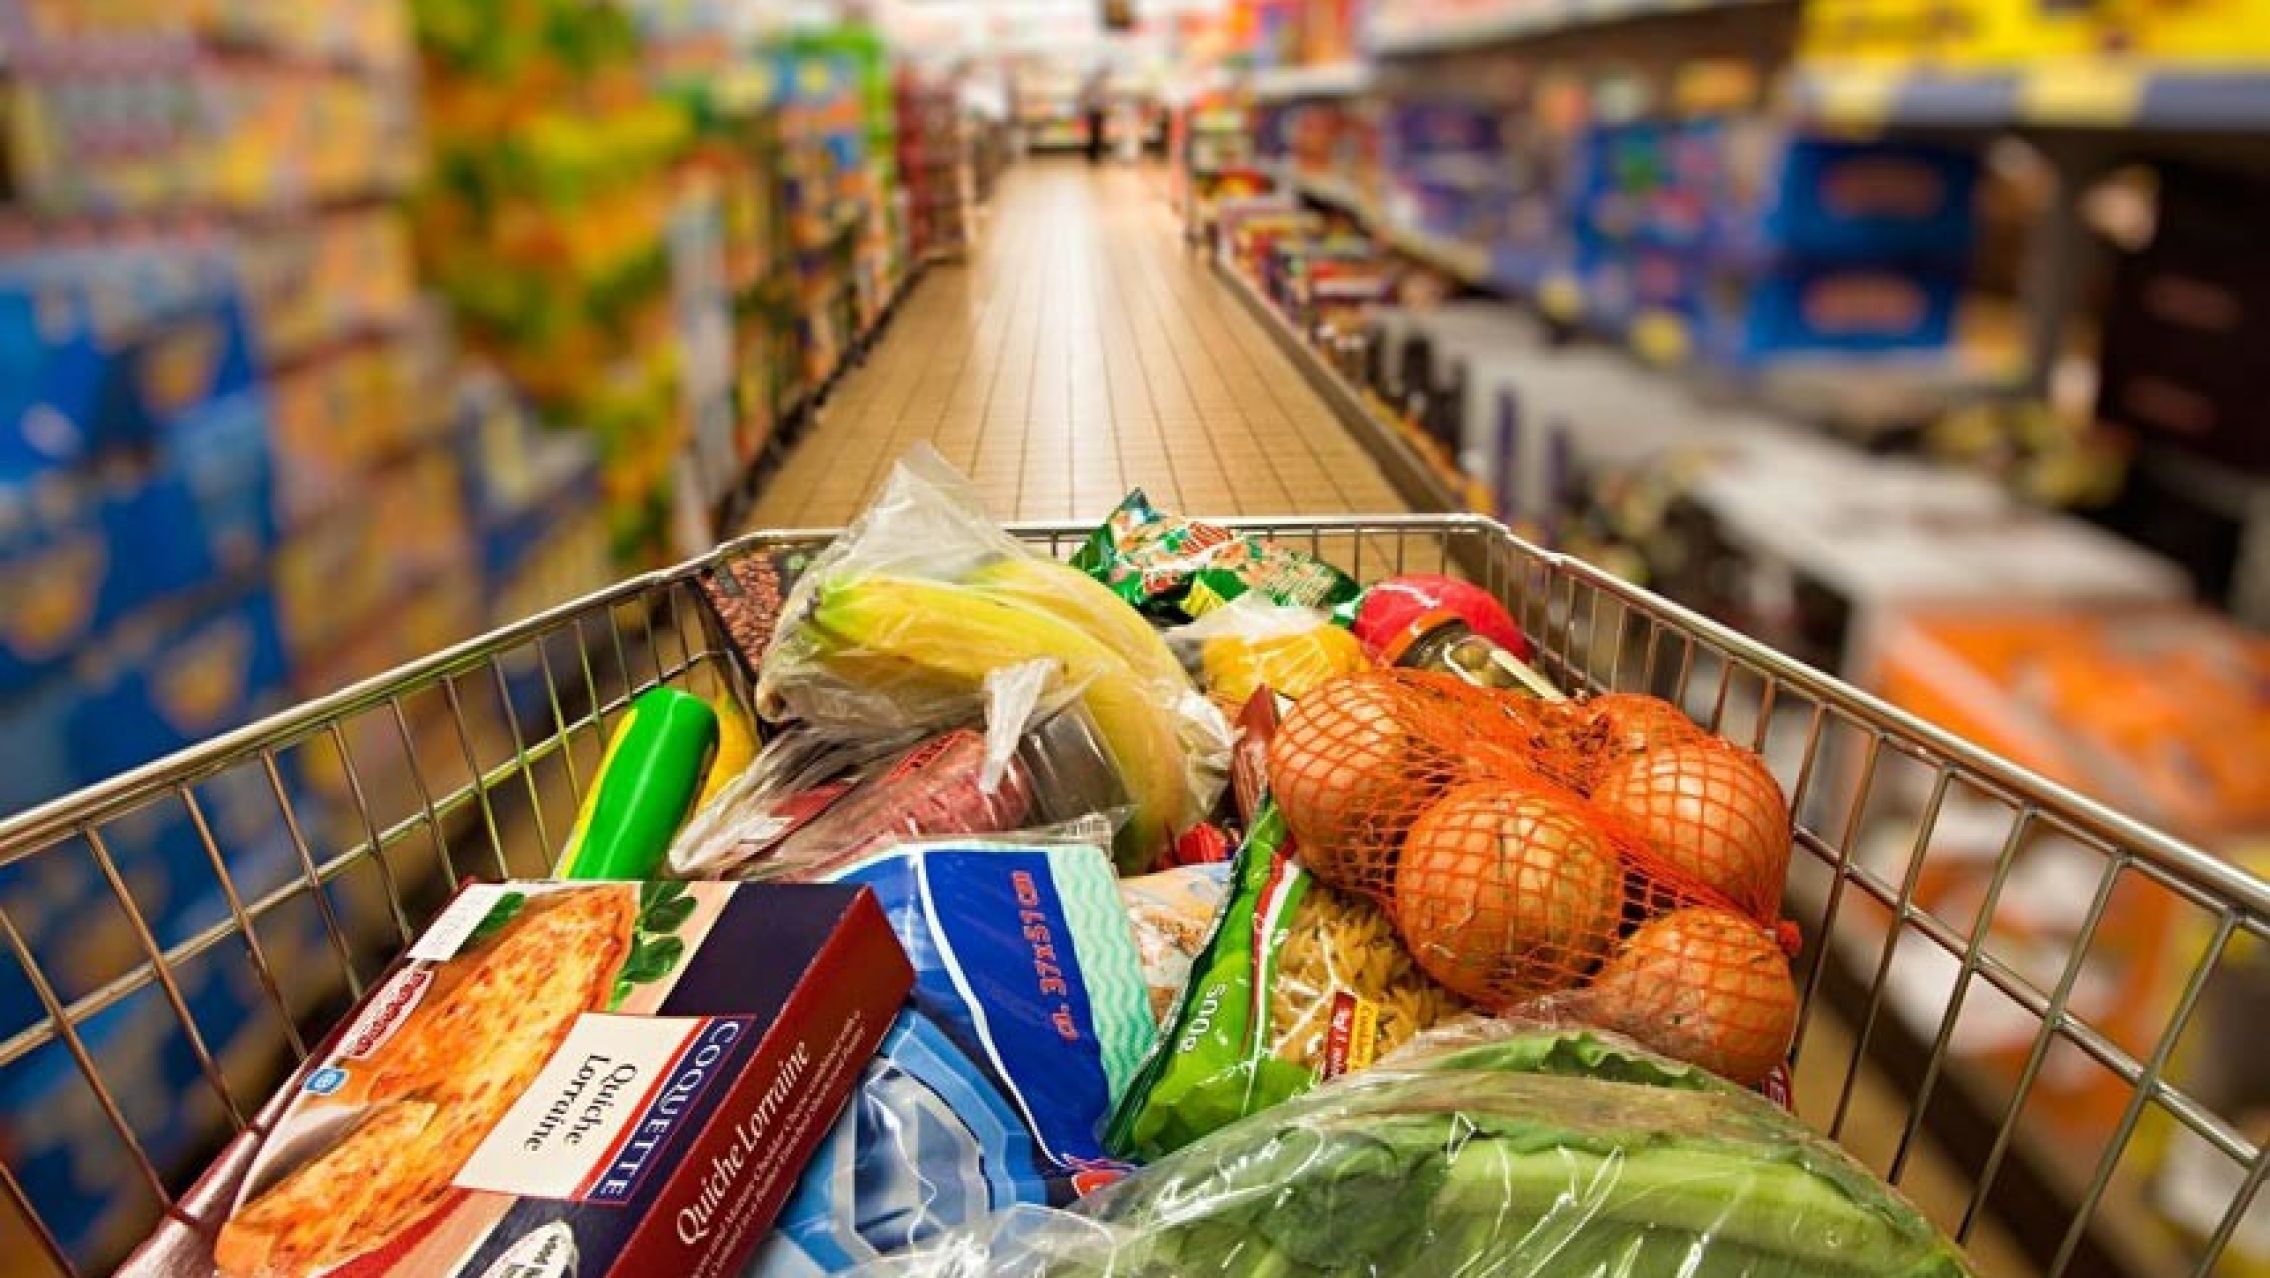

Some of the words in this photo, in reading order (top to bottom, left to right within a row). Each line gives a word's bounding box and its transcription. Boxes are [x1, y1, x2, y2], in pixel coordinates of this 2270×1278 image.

[524, 1053, 611, 1152] Lorraine
[564, 1063, 638, 1144] Quiche
[600, 1020, 739, 1196] COQUETTE
[676, 1145, 744, 1244] Quiche
[735, 1040, 810, 1152] Lorraine
